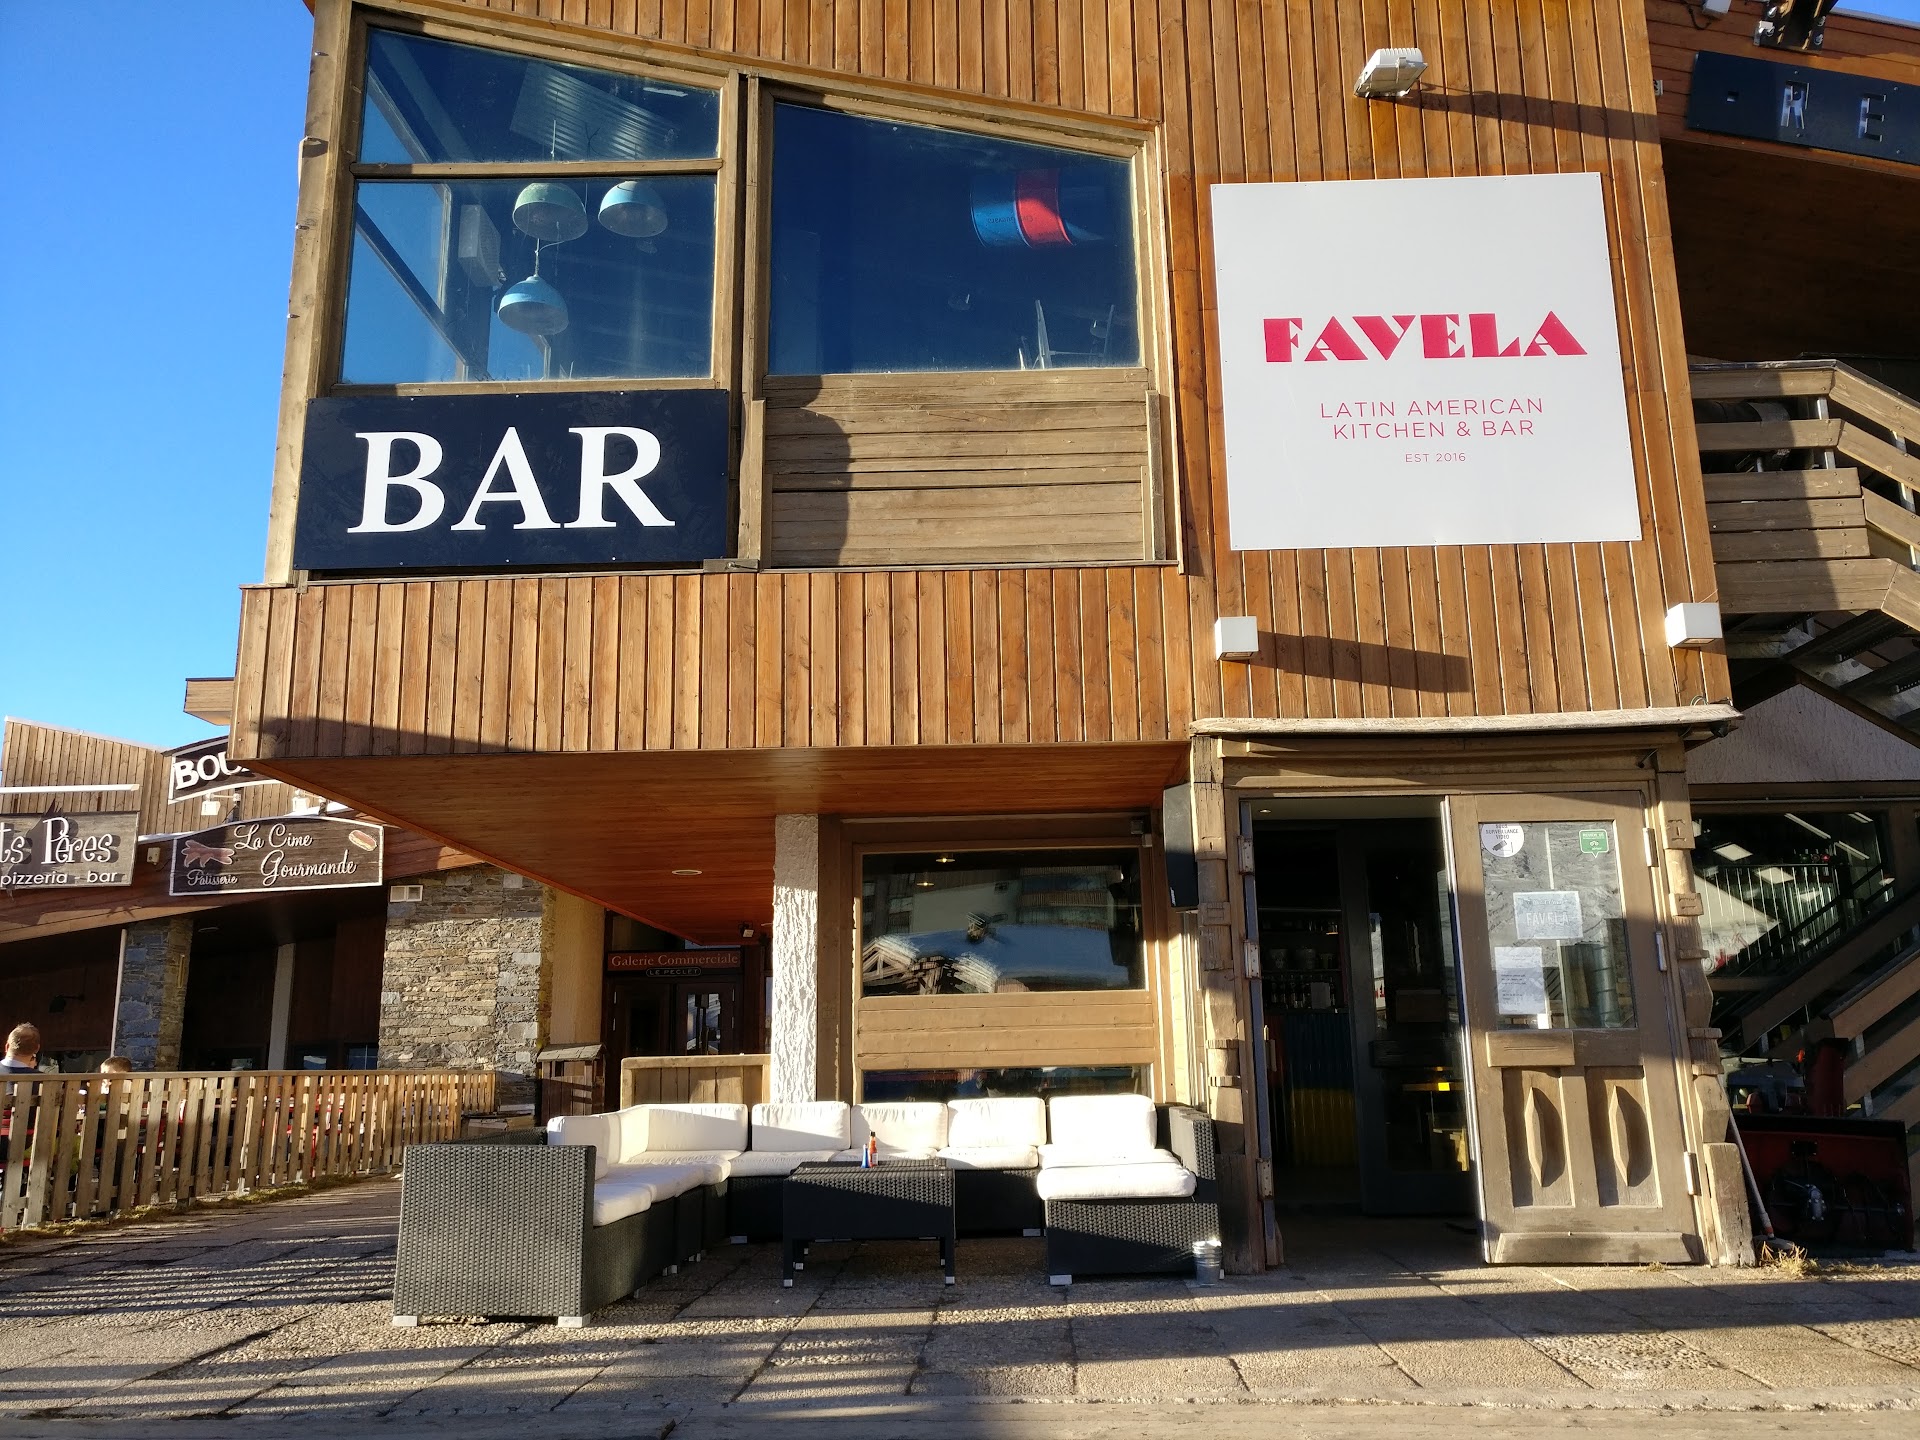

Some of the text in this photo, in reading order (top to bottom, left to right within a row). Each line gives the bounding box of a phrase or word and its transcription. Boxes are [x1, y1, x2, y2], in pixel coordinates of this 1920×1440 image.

[1263, 311, 1588, 362] FAVELA
[1320, 398, 1544, 419] LATIN AMERICAN
[1333, 419, 1535, 440] KITCHEN & BAR
[1404, 452, 1467, 463] EST 2016
[346, 426, 676, 533] BAR
[173, 751, 250, 790] BOU
[233, 823, 313, 850] La Cime
[260, 849, 357, 887] Gourmande
[0, 871, 68, 888] pizzeria
[87, 870, 118, 883] bar
[1526, 911, 1569, 926] FAVELA
[611, 953, 738, 966] Galerie Commerciale
